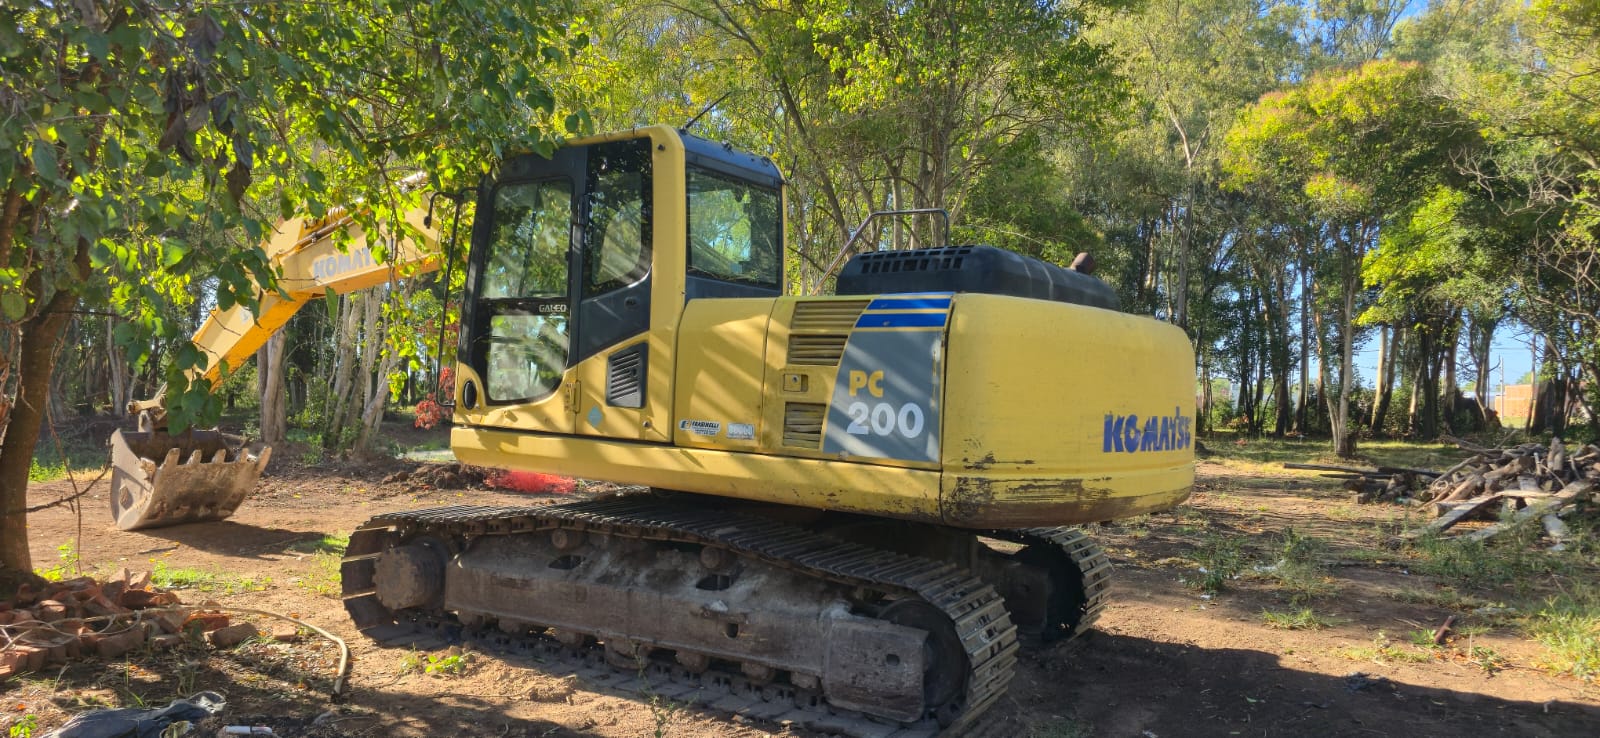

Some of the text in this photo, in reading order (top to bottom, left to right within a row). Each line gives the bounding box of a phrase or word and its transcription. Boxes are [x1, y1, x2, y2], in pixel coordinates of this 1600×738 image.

[538, 304, 567, 313] GALEO
[848, 368, 885, 399] PC
[846, 401, 925, 439] 200
